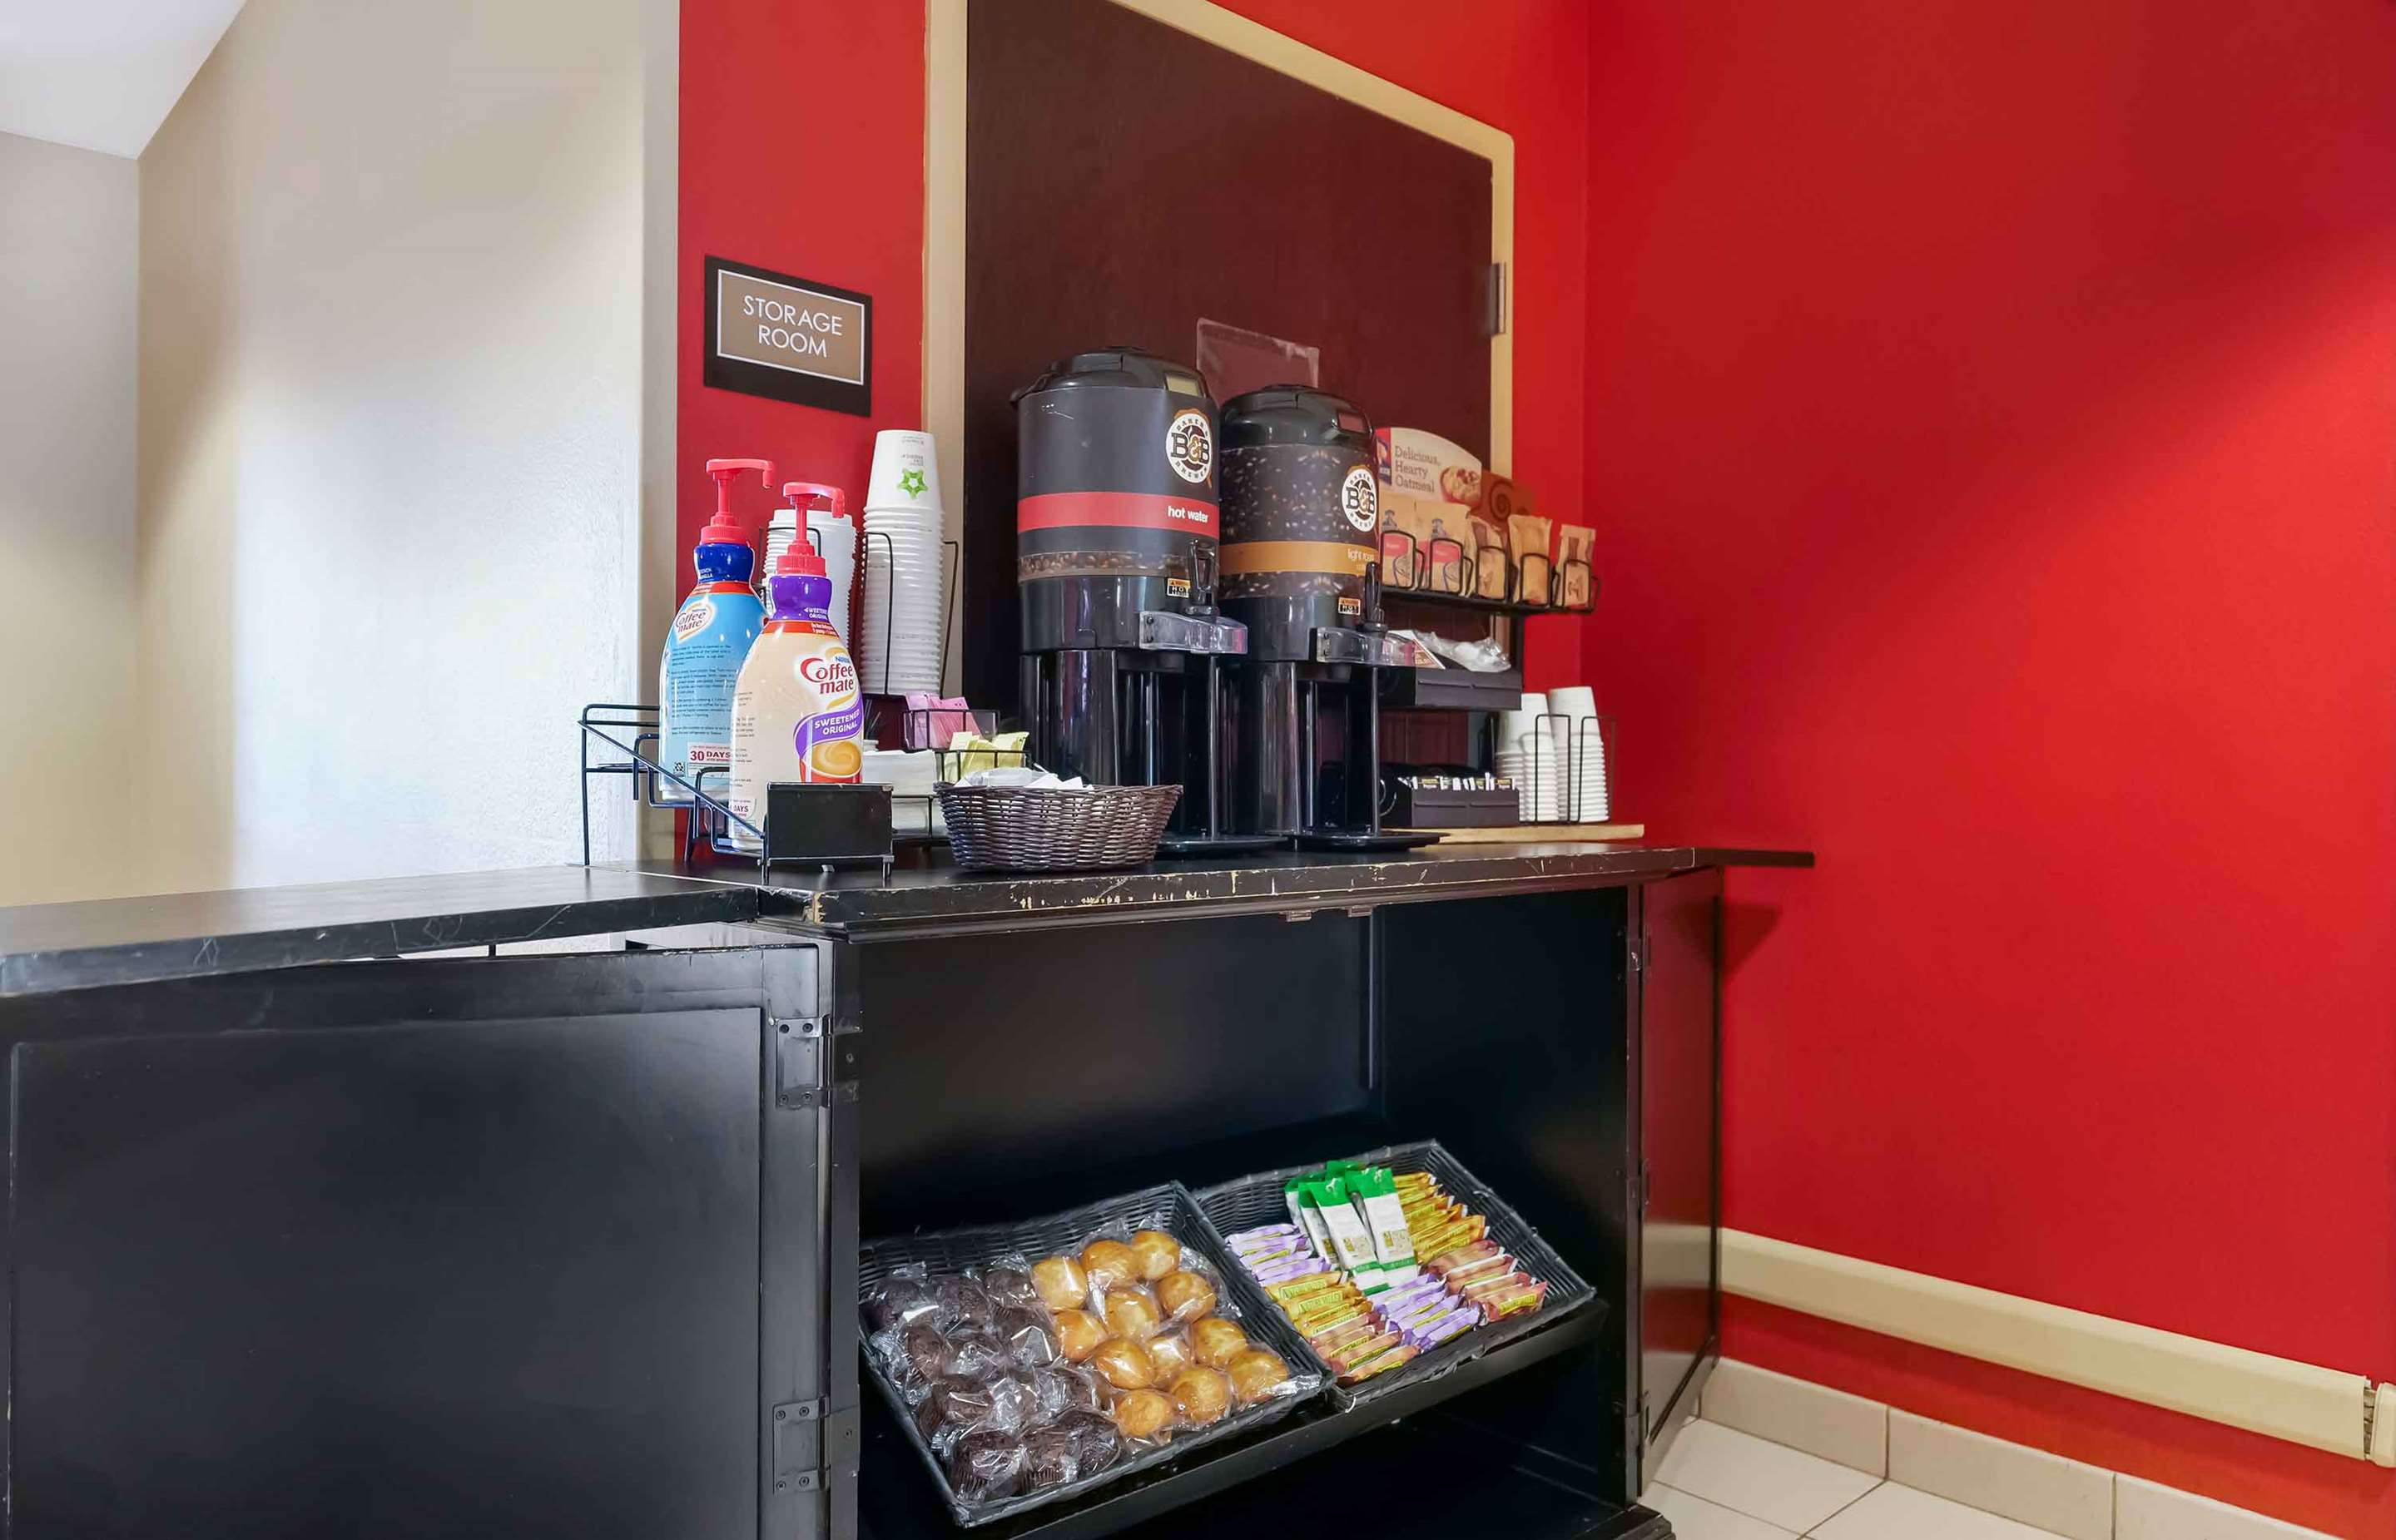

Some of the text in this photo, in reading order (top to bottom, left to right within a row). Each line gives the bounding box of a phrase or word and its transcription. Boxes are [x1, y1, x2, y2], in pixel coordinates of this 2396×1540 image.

[743, 295, 843, 336] STORAGE
[758, 324, 828, 358] ROOM
[1170, 432, 1210, 465] B&B
[1395, 459, 1429, 480] Hearty
[1395, 474, 1435, 493] Oatmeal
[1167, 505, 1209, 523] hot water
[675, 612, 707, 628] Coffee
[800, 657, 853, 682] Coffee
[819, 679, 854, 695] mate
[822, 720, 858, 735] ORIGINAL
[690, 750, 705, 761] 30
